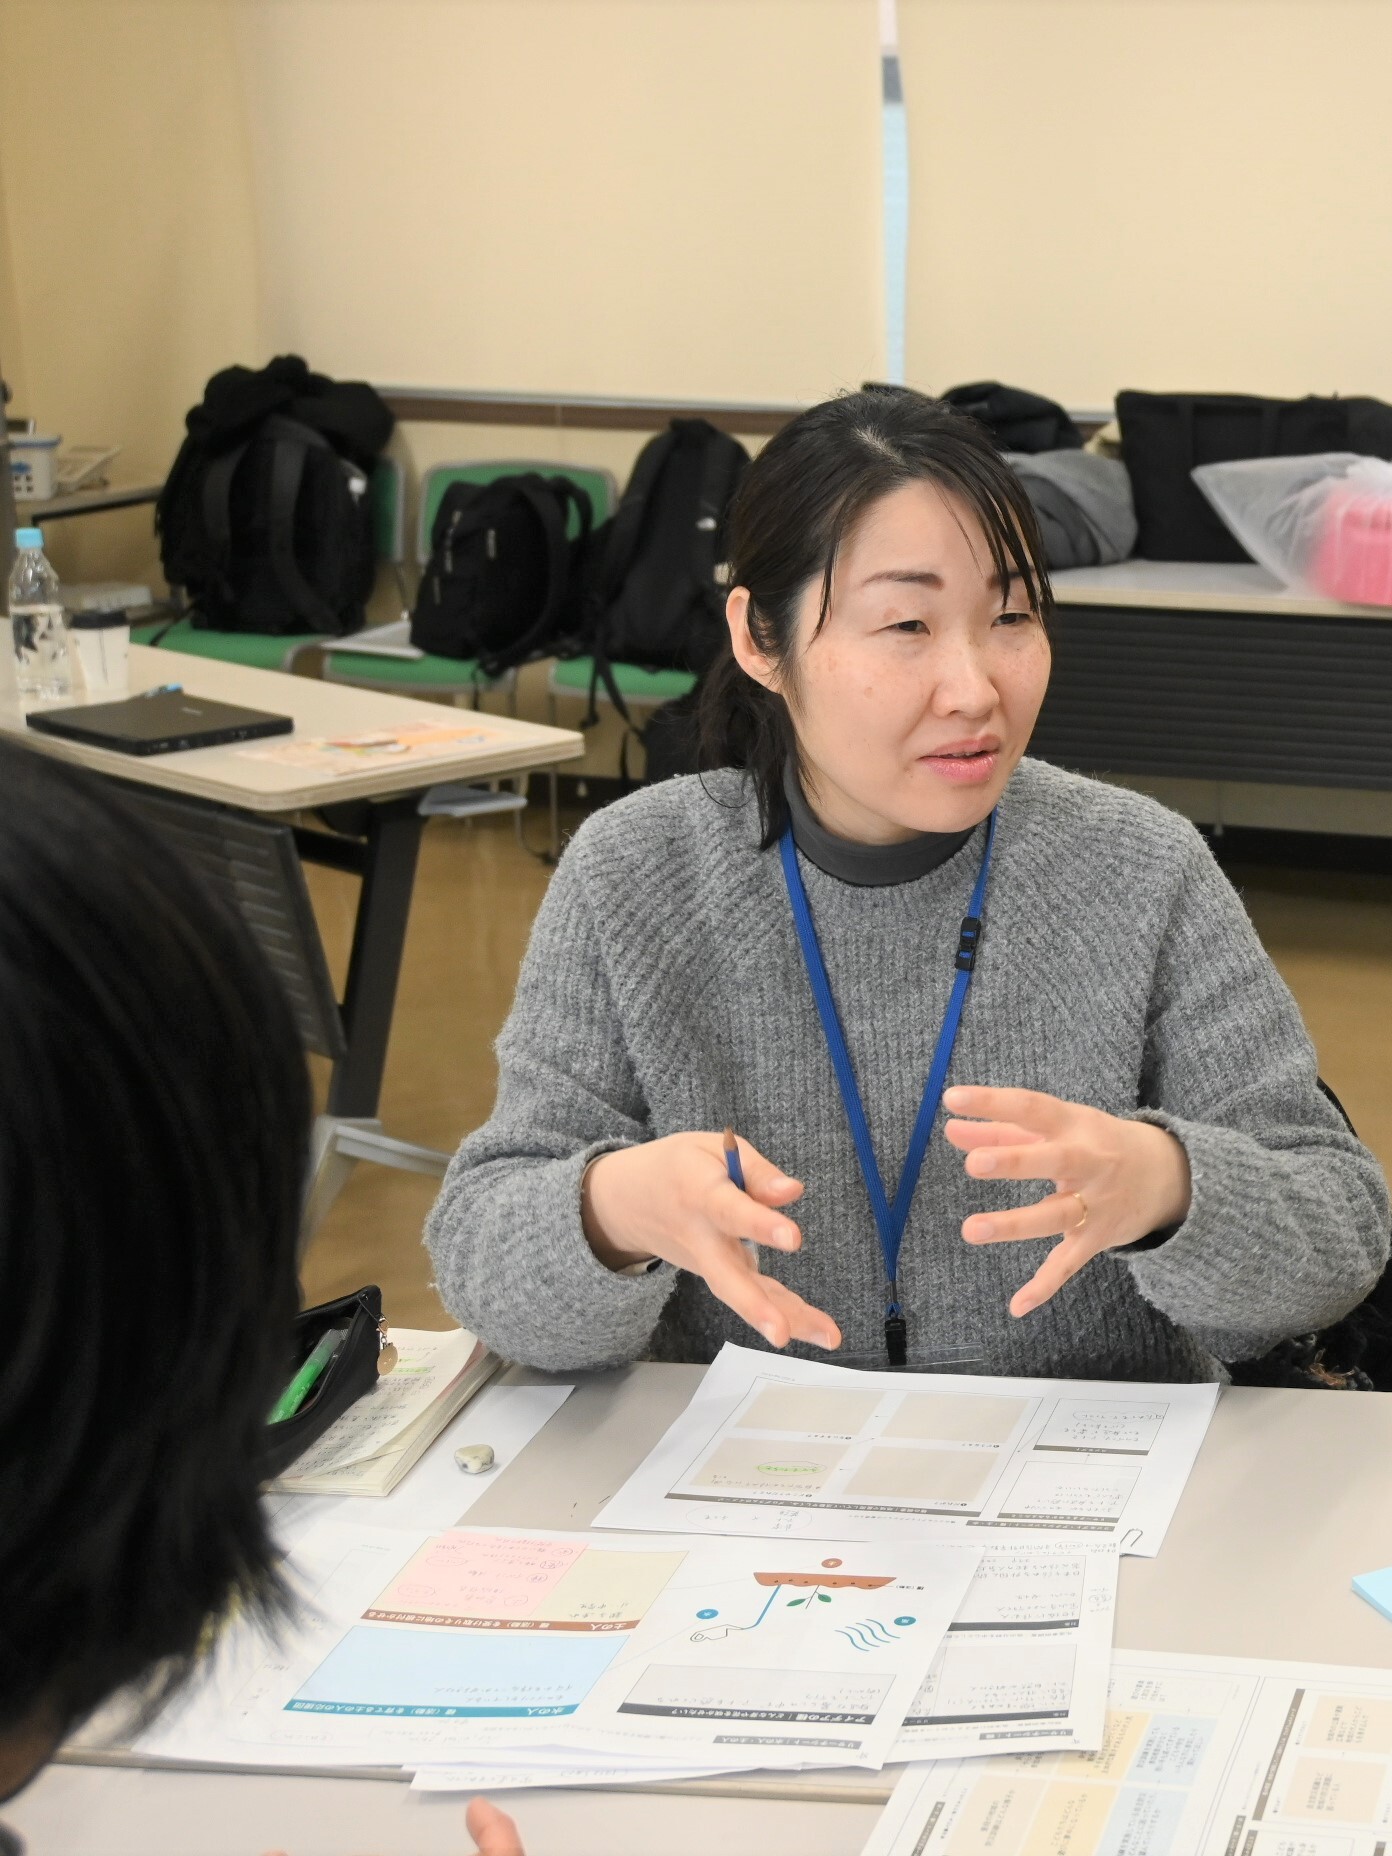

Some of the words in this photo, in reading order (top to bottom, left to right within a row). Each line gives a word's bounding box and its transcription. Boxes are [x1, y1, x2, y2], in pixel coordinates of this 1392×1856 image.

[293, 1702, 456, 1715] 種（活動）を育てる土の人の応援団
